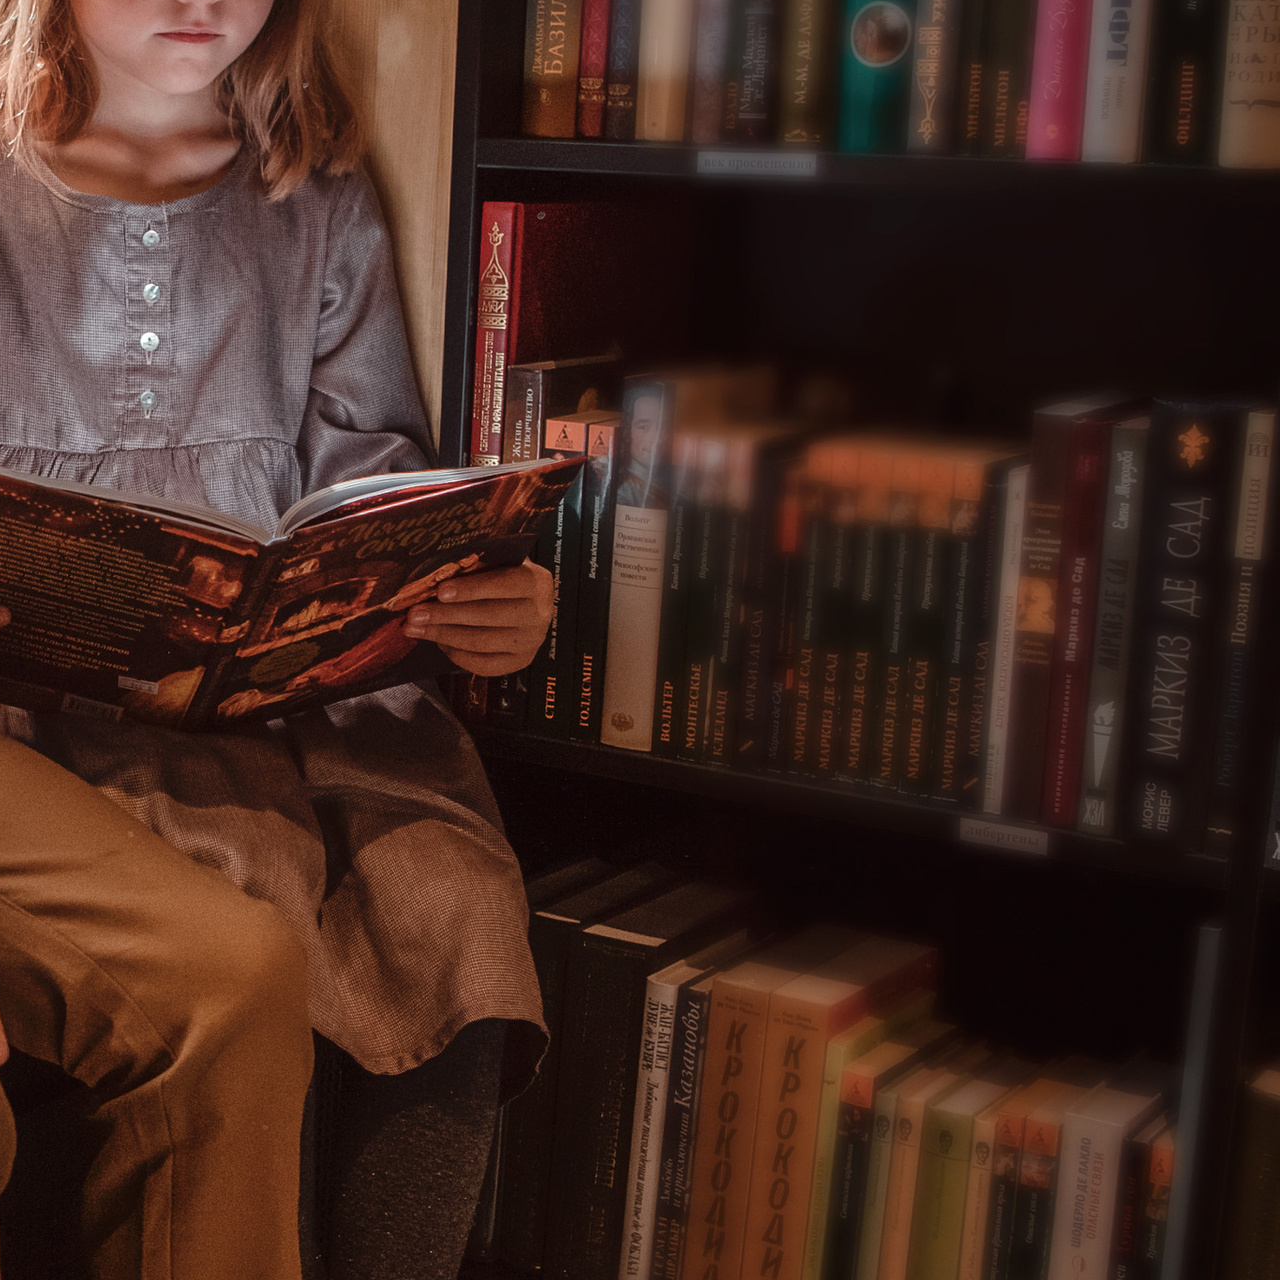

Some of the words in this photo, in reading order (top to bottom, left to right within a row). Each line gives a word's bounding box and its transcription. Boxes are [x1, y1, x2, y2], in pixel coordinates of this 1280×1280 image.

[743, 17, 758, 70] Мадлен
[796, 39, 812, 60] ДЕ
[740, 74, 756, 113] Мари
[792, 64, 809, 105] М.-М.
[965, 62, 983, 139] МИЛЬТОН
[1176, 60, 1196, 146] ФИЛДИНГ
[992, 70, 1011, 148] МИЛЬТОН
[704, 158, 726, 169] век
[493, 352, 505, 383] ИТАЛИИ
[491, 422, 502, 435] ПО
[523, 388, 535, 449] ТВОРЧЕСТВО
[1114, 450, 1138, 500] Морозова
[1112, 503, 1130, 530] Елена
[1165, 496, 1212, 559] САД
[1241, 479, 1261, 558] полиция
[1071, 557, 1086, 584] Сад
[1105, 559, 1130, 585] САД
[1241, 565, 1254, 577] и
[1069, 587, 1083, 606] де
[1104, 590, 1128, 610] ДЕ
[1160, 577, 1203, 619] ДЕ
[1230, 582, 1252, 645] Поэзия
[1064, 608, 1081, 662] Маркиз
[1097, 613, 1120, 671] МАРКИЗ
[799, 648, 813, 678] САД
[824, 653, 839, 683] САД
[853, 651, 869, 682] САД
[886, 664, 901, 694] САД
[914, 660, 929, 691] САД
[544, 676, 557, 720] СТЕРН
[579, 653, 594, 728] ГОЛДСМИТ
[661, 681, 675, 742] ВОЛЬТЕР
[685, 662, 702, 749] МОНТЕСКЬЕ
[745, 660, 758, 721] МАРКИЗ
[797, 679, 811, 700] ДЕ
[822, 686, 836, 707] ДЕ
[851, 685, 866, 706] ДЕ
[884, 697, 898, 716] ДЕ
[911, 694, 926, 715] ДЕ
[948, 675, 962, 706] САД
[1059, 673, 1073, 745] РАССЛЕДОВАНИЕ
[1146, 634, 1192, 761] МАРКИЗ
[712, 689, 729, 757] КЛЕЛАНД
[793, 701, 808, 762] МАРКИЗ
[818, 709, 834, 770] МАРКИЗ
[847, 708, 864, 769] МАРКИЗ
[945, 707, 960, 728] ДЕ
[880, 718, 896, 778] МАРКИЗ
[907, 718, 923, 780] МАРКИЗ
[941, 729, 957, 791] МАРКИЗ
[1054, 748, 1066, 814] ИСТОРИЧЕСКОЕ
[1141, 782, 1158, 831] МОРИС
[1157, 789, 1172, 833] ЛЕВЕР
[966, 825, 1039, 846] либертены
[673, 1000, 702, 1109] Казановы
[673, 1112, 690, 1198] приключения
[1077, 1136, 1092, 1176] ЛАКЛО
[1090, 1151, 1105, 1186] СВЯЗИ
[659, 1158, 674, 1206] Любовь
[1076, 1178, 1090, 1195] ДЕ
[1070, 1196, 1087, 1248] ШОДЕРЛО
[1084, 1188, 1102, 1240] ОПАСНЫЕ
[652, 1216, 668, 1277] ГЕРМАН
[665, 1219, 681, 1280] ШРАЙБЕР
